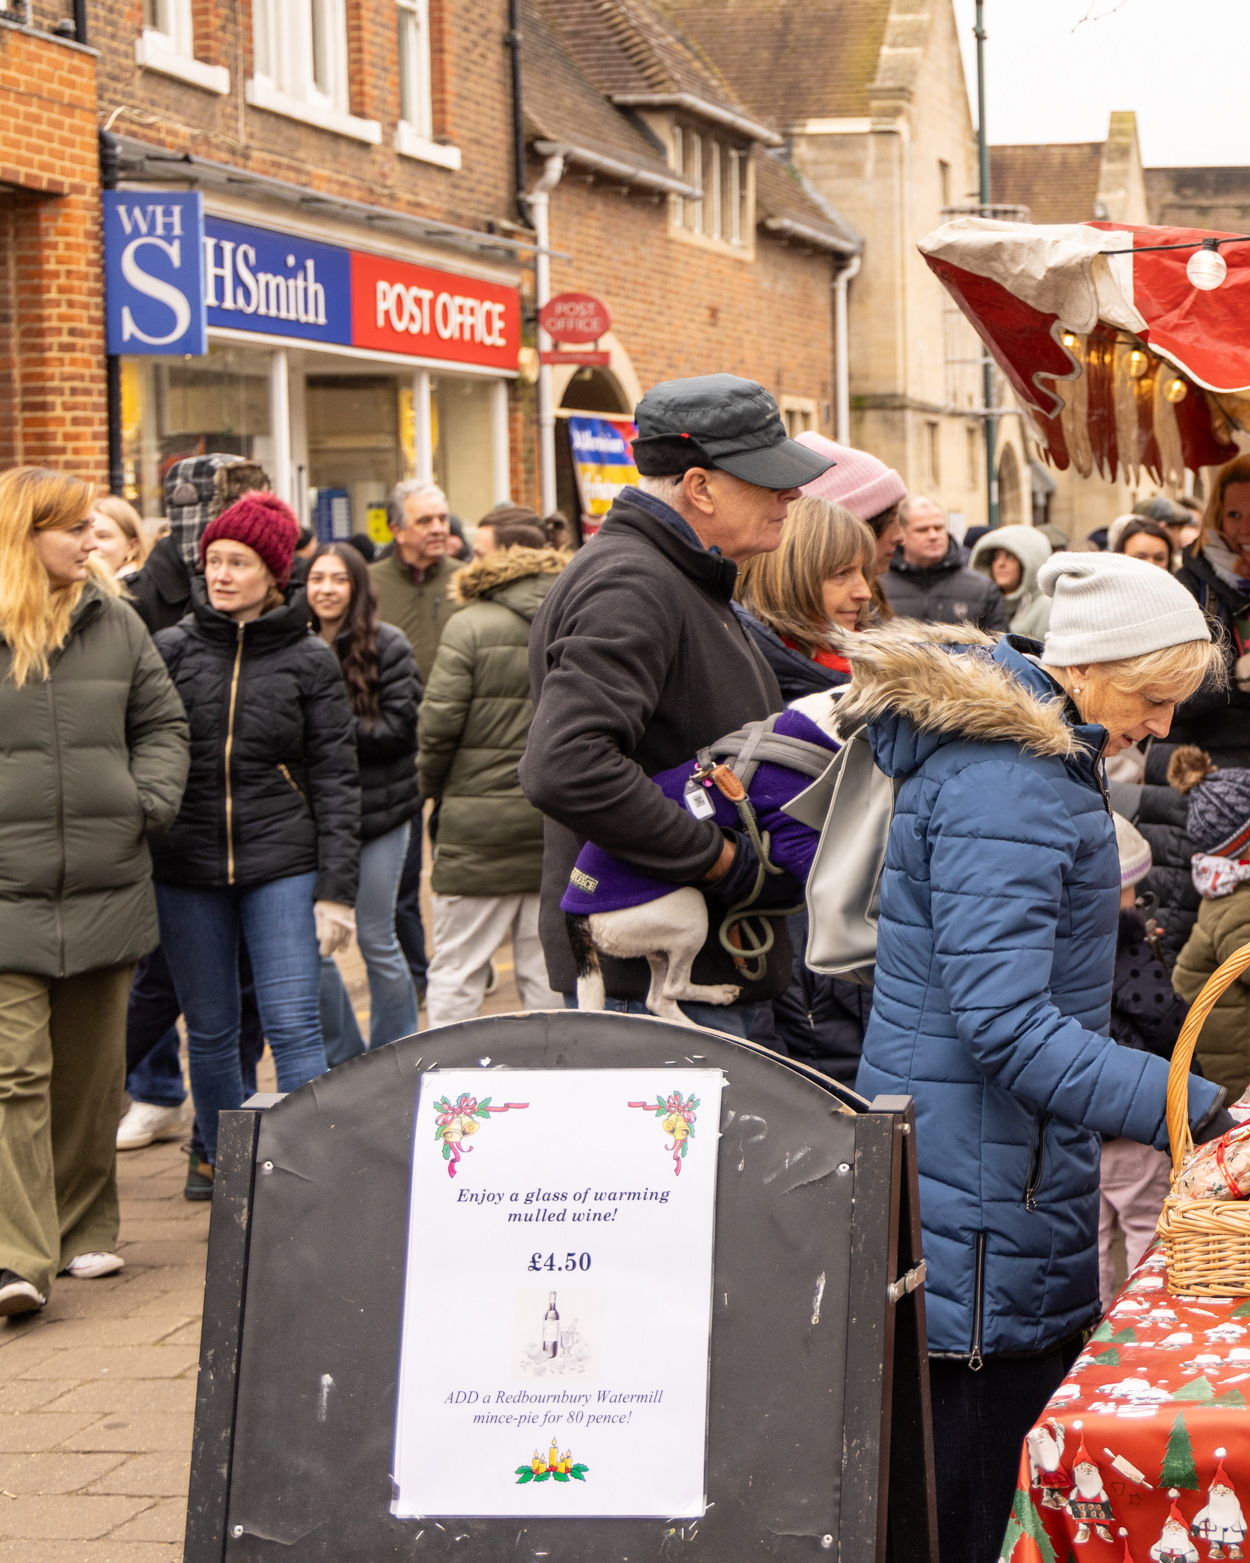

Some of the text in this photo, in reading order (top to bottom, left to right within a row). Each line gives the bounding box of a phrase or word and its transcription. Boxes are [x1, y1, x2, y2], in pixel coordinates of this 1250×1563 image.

[116, 204, 184, 237] WH
[202, 236, 328, 326] HSmith
[121, 236, 191, 345] S
[376, 280, 507, 348] POST OFFICE
[554, 301, 596, 317] POST
[544, 316, 602, 334] OFFICE
[457, 1188, 670, 1205] Enjoy a glass of warming
[508, 1208, 618, 1223] mulled wine!
[527, 1252, 592, 1272] £4.50
[444, 1390, 664, 1407] ADD a Redbournbury Watermill
[473, 1411, 632, 1427] mince-pie for 80 pence!
